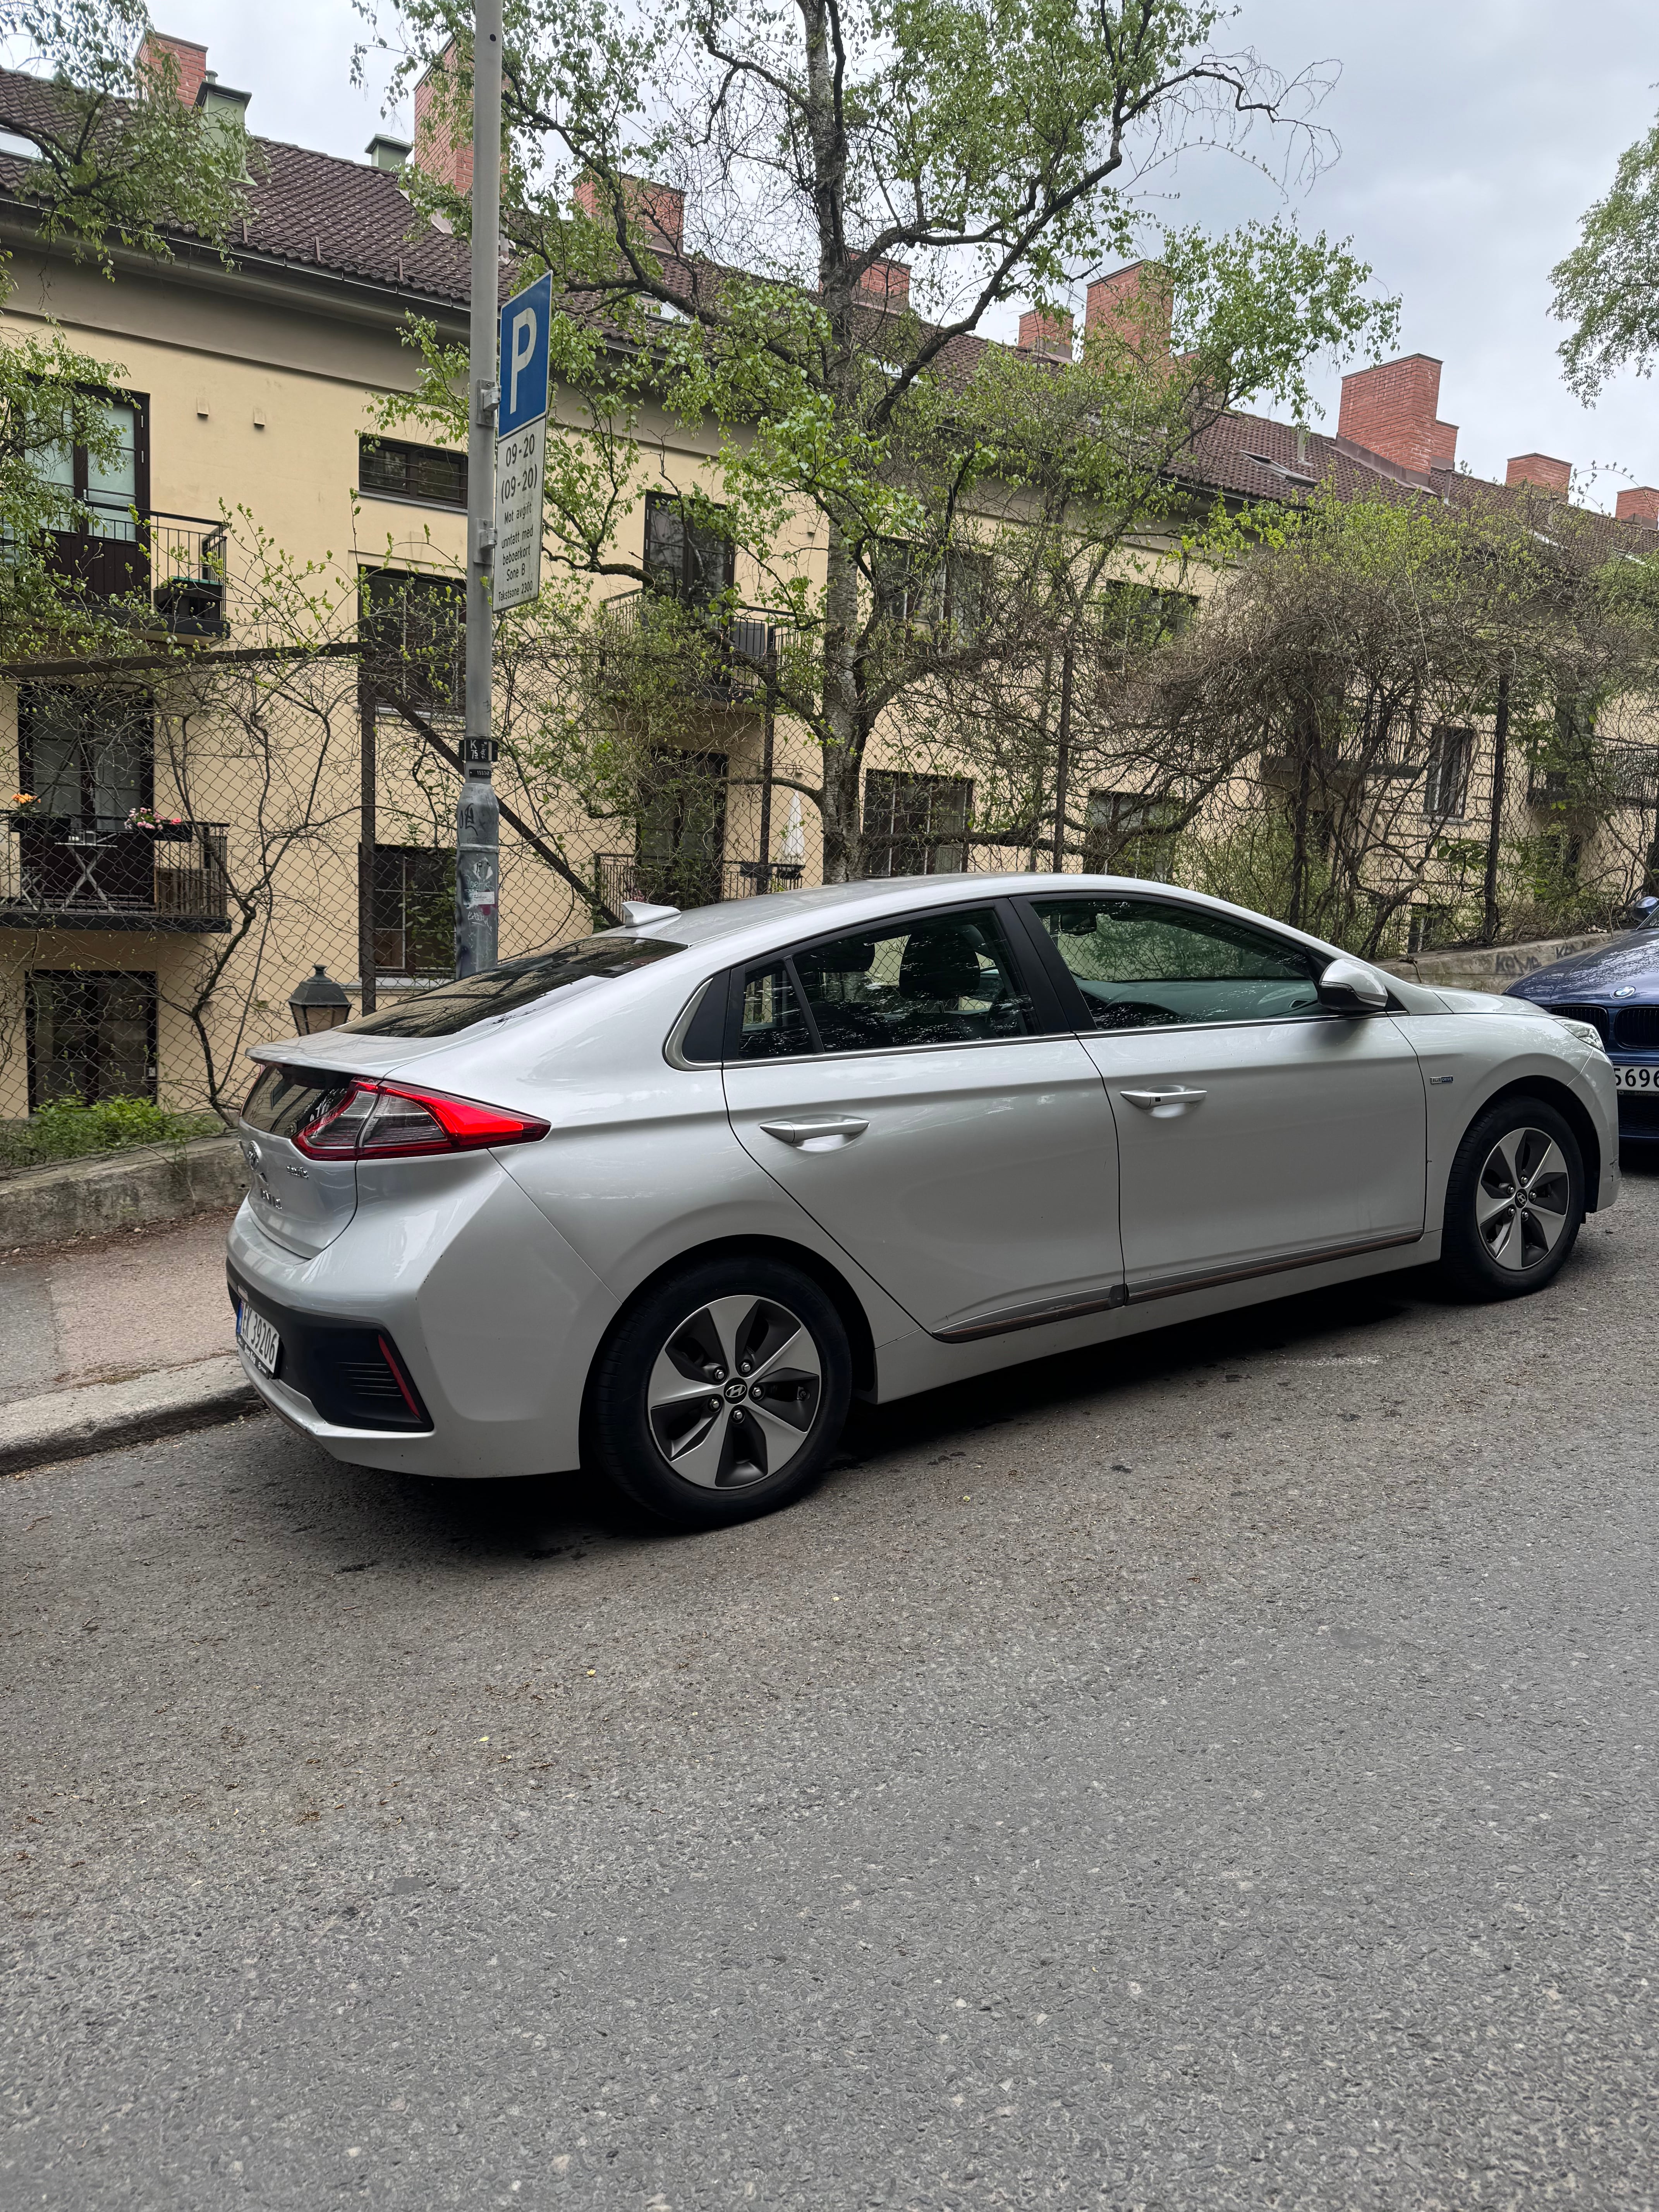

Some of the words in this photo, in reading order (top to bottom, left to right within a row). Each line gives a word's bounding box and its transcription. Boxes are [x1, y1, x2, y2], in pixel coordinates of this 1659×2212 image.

[510, 307, 537, 414] P
[506, 433, 534, 467] 09-20
[501, 464, 537, 504] (09-20)
[505, 509, 514, 524] Mot
[516, 501, 532, 519] avgift
[501, 531, 520, 549] unntatt
[522, 524, 533, 541] med
[503, 543, 530, 565] beboerkort
[507, 568, 519, 581] Sone
[522, 563, 525, 575] B
[498, 587, 519, 601] Takstsone
[521, 580, 532, 594] 2300
[471, 740, 477, 749] K
[471, 750, 478, 759] 75
[243, 1303, 252, 1339] EK
[251, 1313, 277, 1365] 39206
